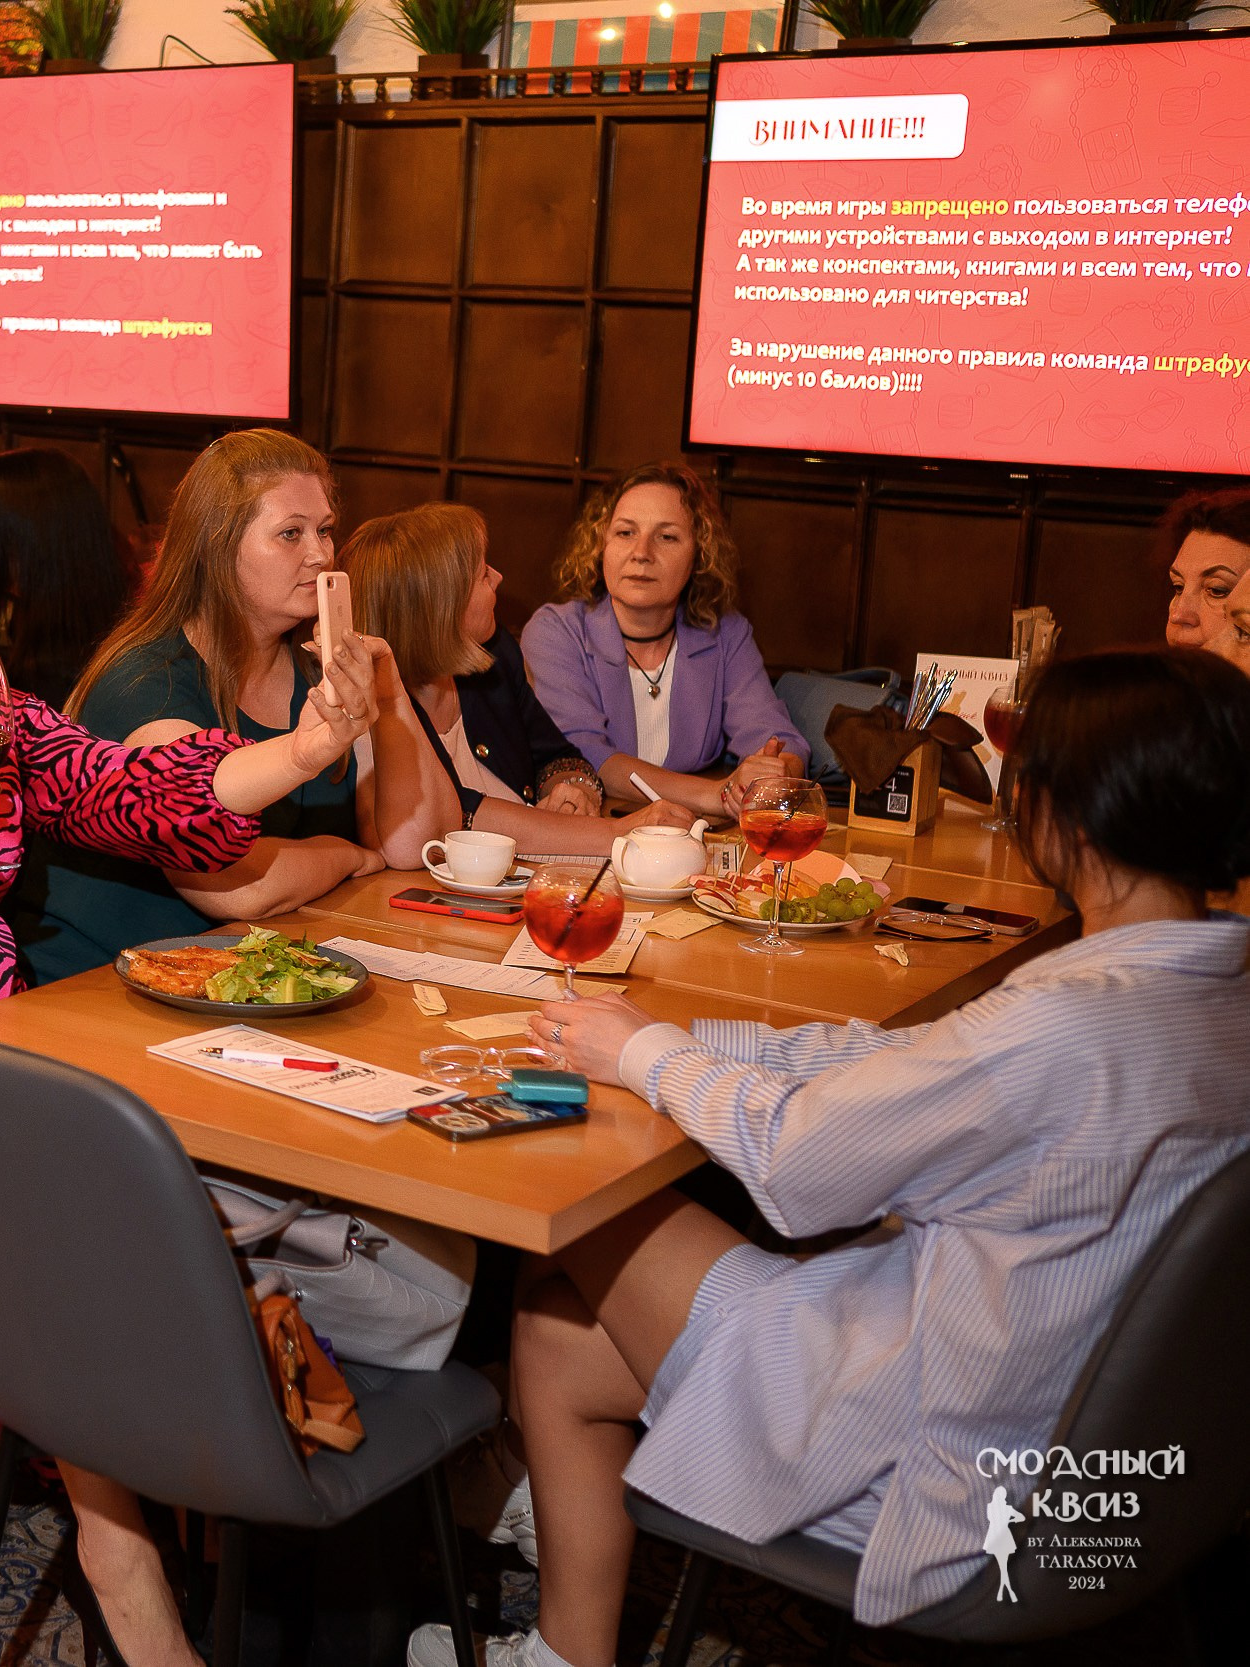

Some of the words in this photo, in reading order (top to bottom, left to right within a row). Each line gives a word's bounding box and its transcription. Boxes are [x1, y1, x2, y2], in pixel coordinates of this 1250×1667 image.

[749, 117, 925, 146] ВНИМАНИЕ!!!
[741, 197, 767, 215] Во
[771, 200, 832, 220] время
[837, 200, 886, 220] игры
[890, 199, 1008, 220] запрещено
[1013, 198, 1168, 215] пользоваться
[738, 229, 821, 248] другими
[825, 225, 968, 249] устройствами
[972, 231, 984, 245] с
[989, 230, 1089, 250] выходом
[1095, 230, 1108, 245] в
[1114, 225, 1233, 250] интернет!
[736, 254, 751, 272] А
[754, 257, 786, 273] так
[791, 258, 818, 273] же
[823, 258, 960, 279] конспектами,
[966, 260, 1056, 276] книгами
[1061, 261, 1076, 276] и
[1081, 262, 1137, 276] всем
[1143, 262, 1193, 281] тем,
[1199, 262, 1241, 277] что
[734, 285, 869, 302] использовано
[872, 289, 910, 308] для
[914, 287, 1029, 310] читерства!
[729, 338, 752, 357] За
[756, 341, 864, 362] нарушение
[867, 347, 953, 366] данного
[958, 349, 1045, 369] правила
[1050, 352, 1148, 374] команда
[727, 364, 793, 390] (минус
[797, 372, 816, 388] 10
[820, 369, 923, 395] баллов)!!!!
